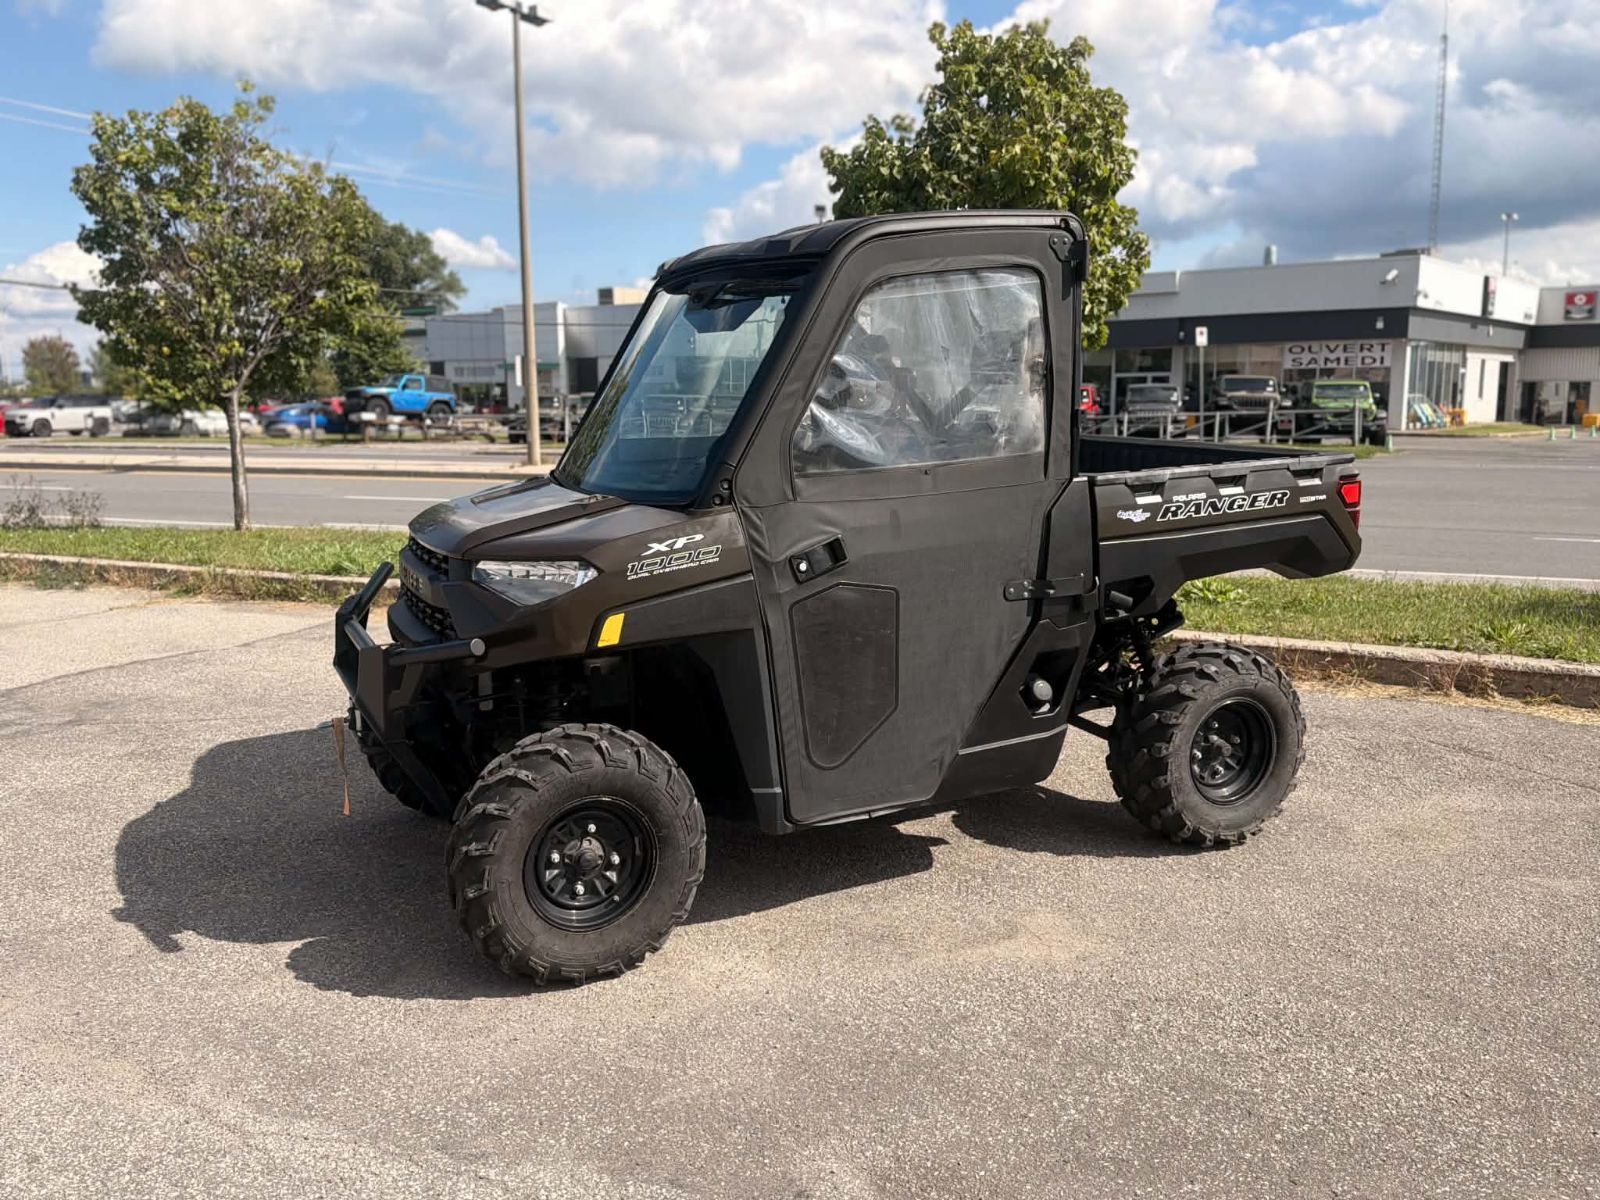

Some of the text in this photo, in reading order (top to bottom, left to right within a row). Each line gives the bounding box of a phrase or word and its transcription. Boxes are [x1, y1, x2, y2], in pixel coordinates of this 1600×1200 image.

[1288, 343, 1390, 355] OUVERT
[1291, 355, 1385, 367] SAMEDI
[1157, 490, 1289, 521] RANGER
[1172, 492, 1207, 502] POLARIS
[640, 533, 704, 556] XP
[627, 545, 722, 575] 1000
